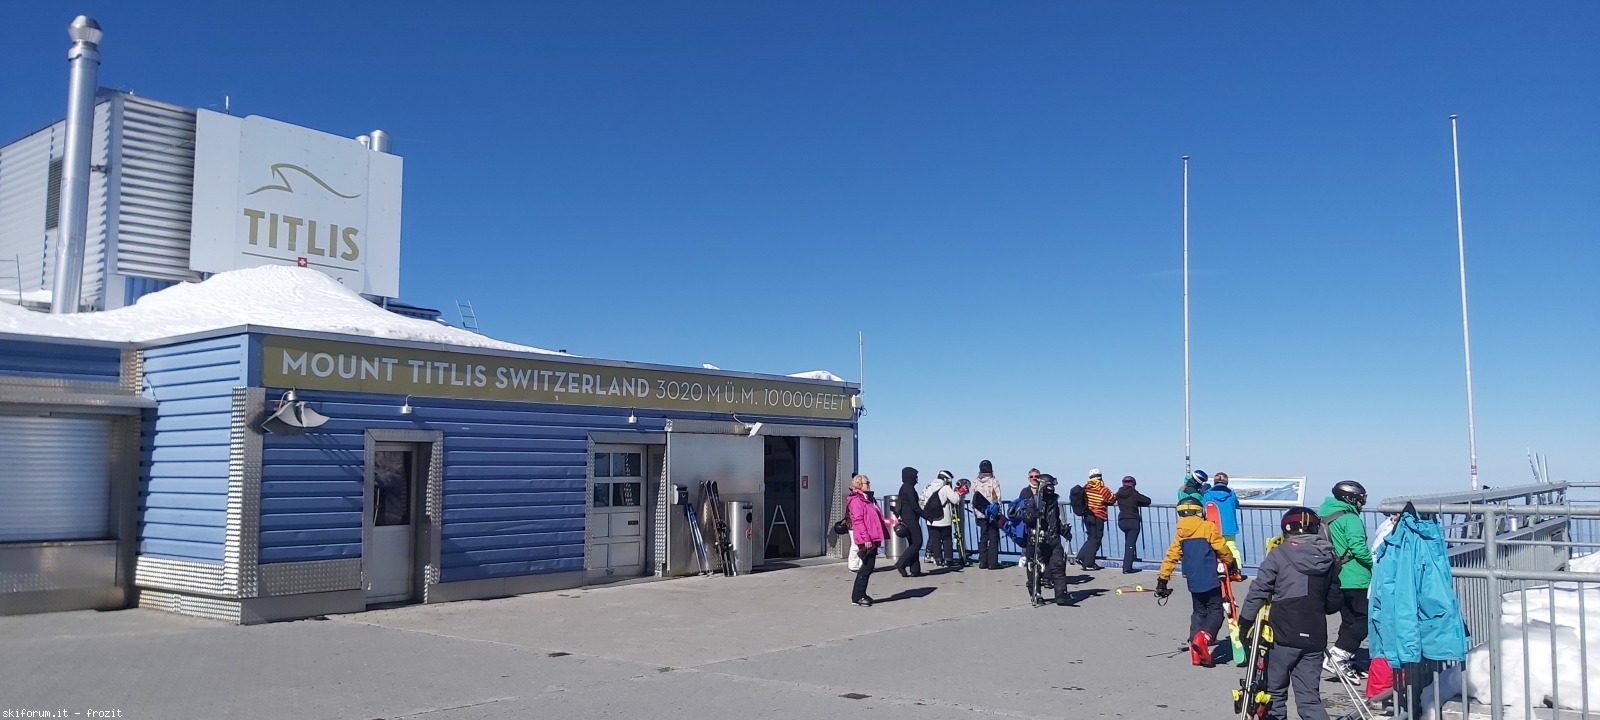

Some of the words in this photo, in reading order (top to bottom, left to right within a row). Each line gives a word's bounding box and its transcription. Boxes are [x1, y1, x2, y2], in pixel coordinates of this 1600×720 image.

[243, 207, 360, 262] TITLIS
[281, 348, 399, 382] MOUNT
[408, 359, 488, 388] TITLIS
[495, 366, 650, 398] SWITZERLAND
[655, 379, 703, 402] 3020
[763, 387, 813, 409] 10'000
[815, 392, 847, 411] FEET
